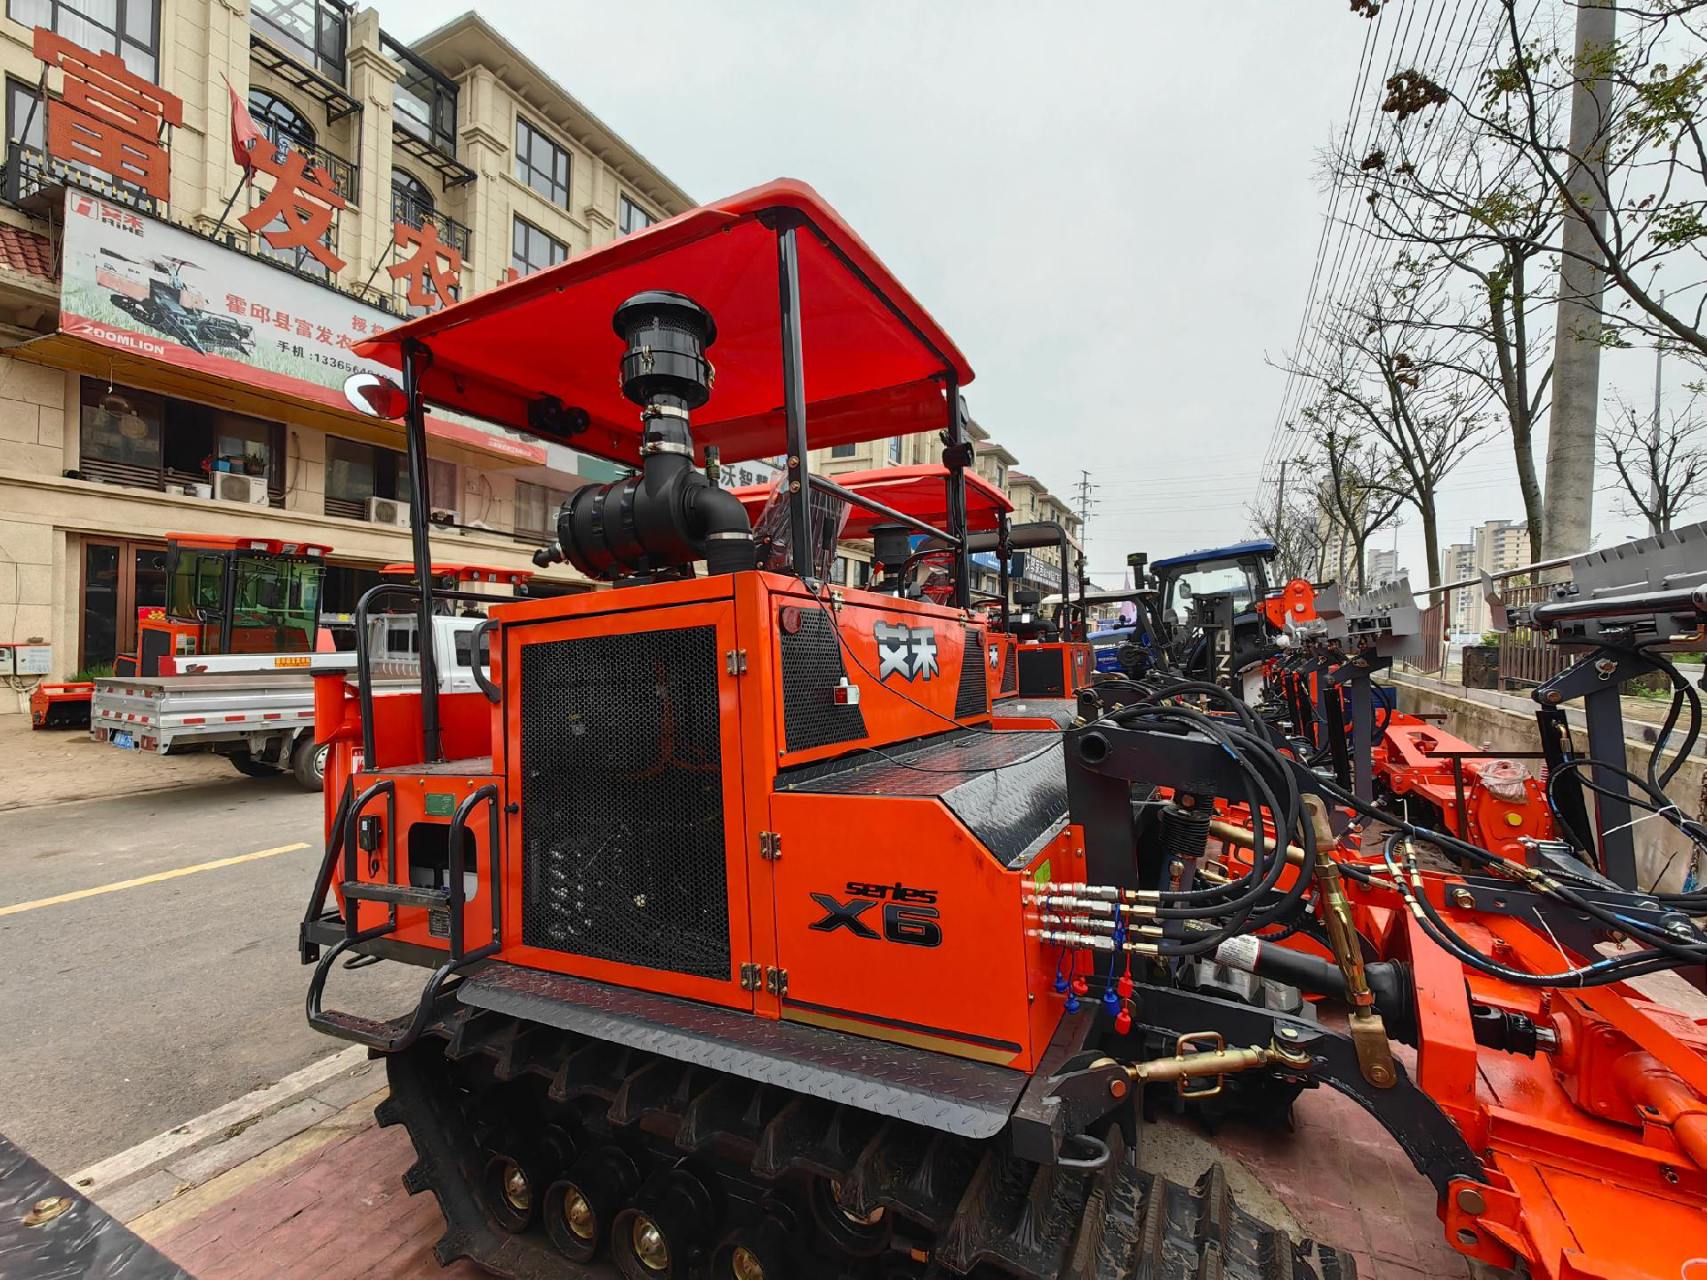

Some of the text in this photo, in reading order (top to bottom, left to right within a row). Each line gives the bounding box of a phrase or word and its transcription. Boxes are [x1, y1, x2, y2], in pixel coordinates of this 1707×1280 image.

[82, 324, 165, 355] ZOOMLION
[874, 620, 939, 683] 艾禾
[845, 881, 938, 904] series
[808, 892, 942, 948] X6
